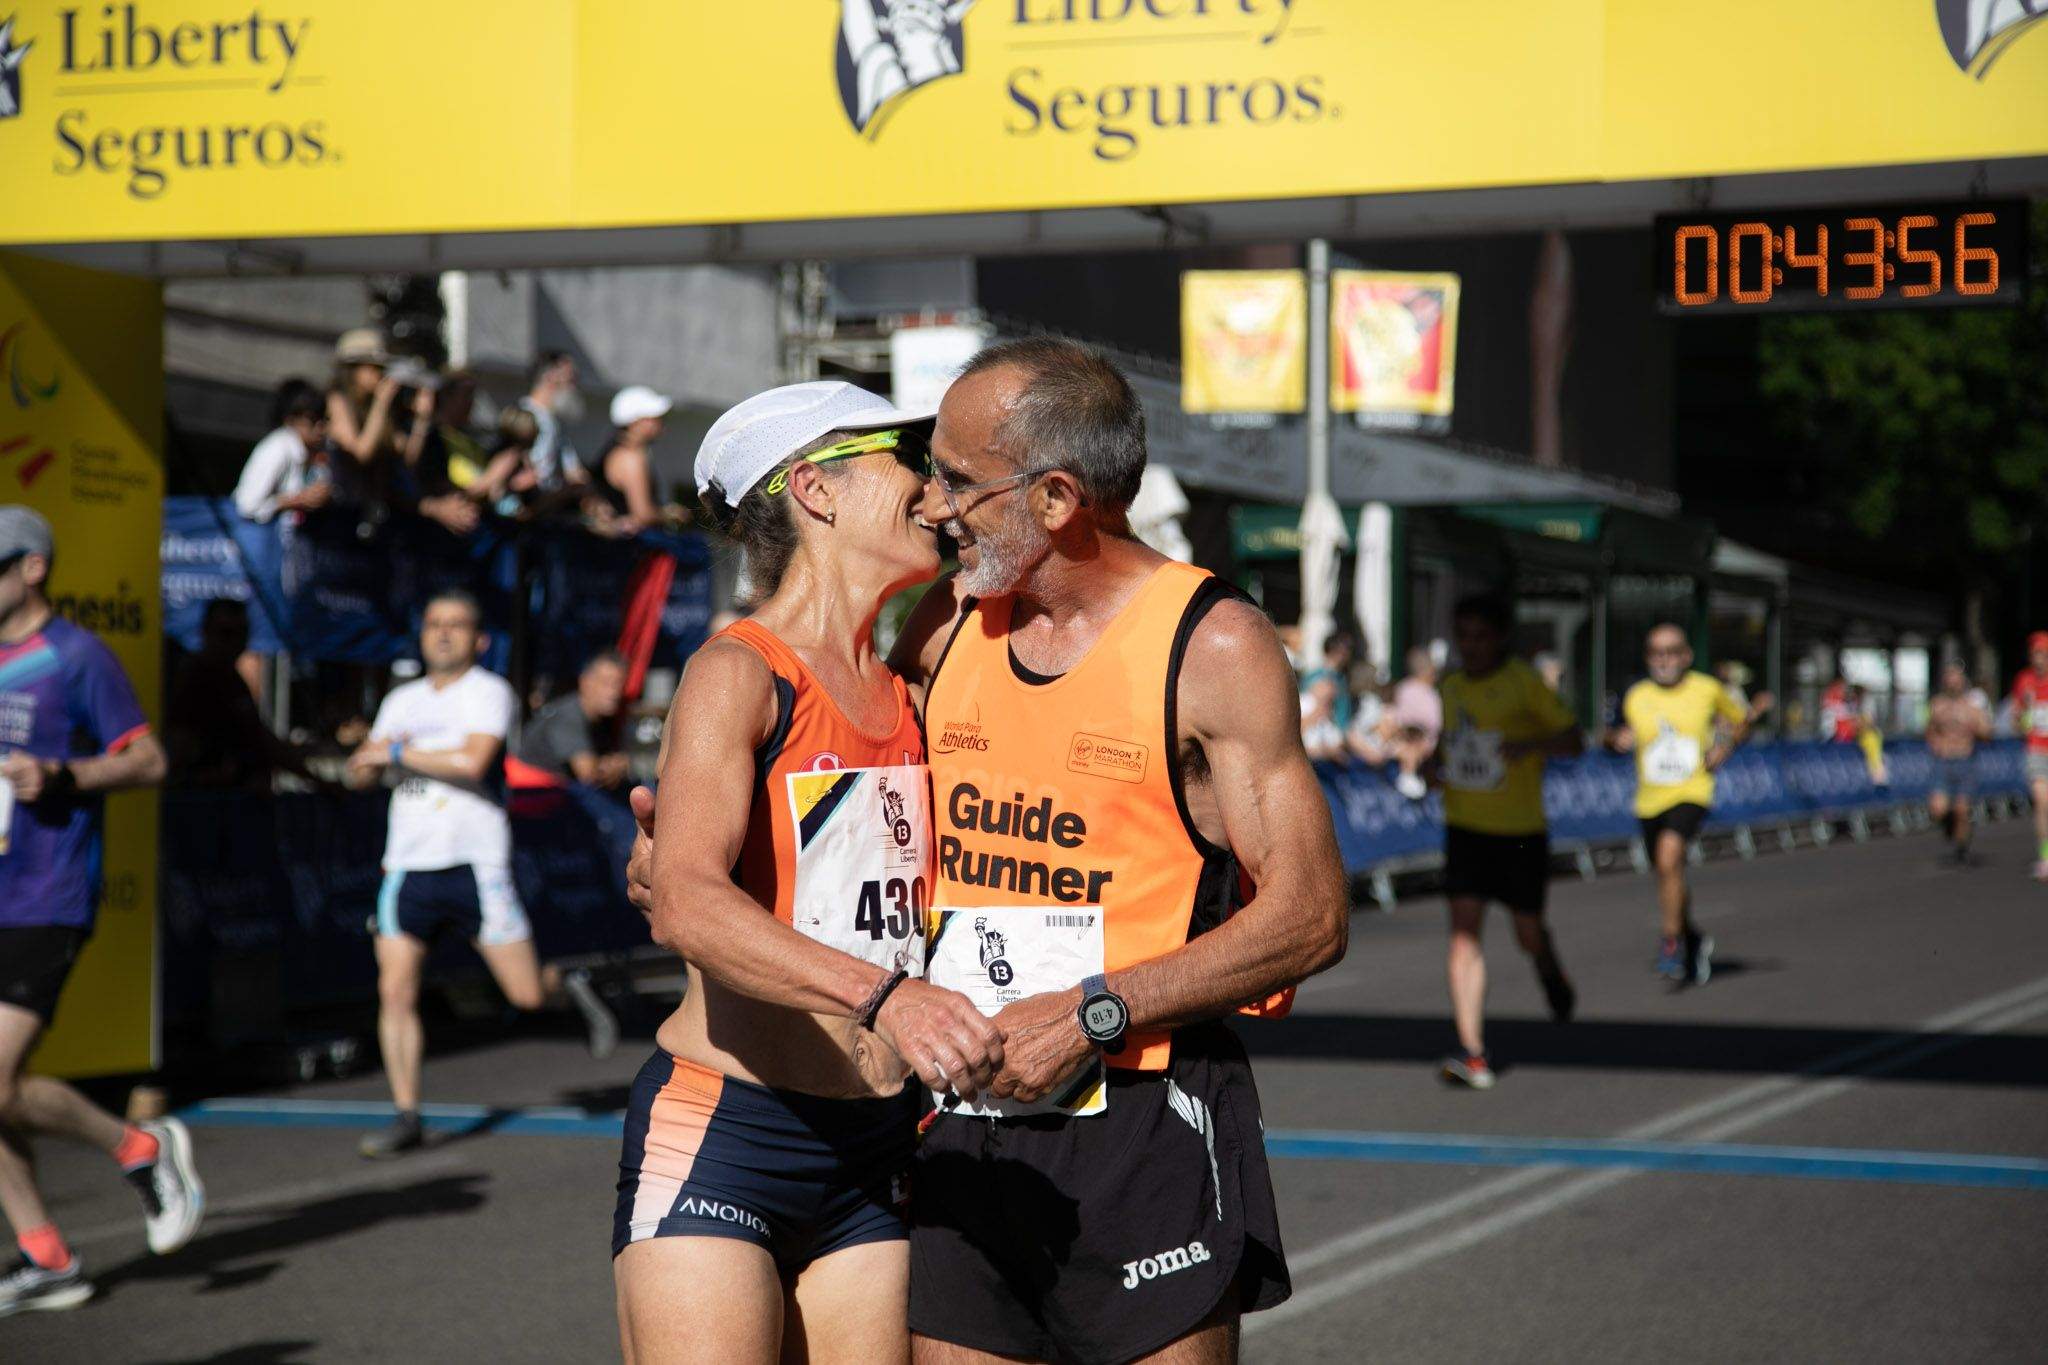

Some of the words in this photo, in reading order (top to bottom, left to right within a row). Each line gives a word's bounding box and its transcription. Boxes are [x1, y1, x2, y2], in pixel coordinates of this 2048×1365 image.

[58, 3, 312, 93] Liberty
[1675, 212, 1999, 305] 00:43:56
[55, 579, 146, 636] nesis
[939, 731, 990, 751] Athletics
[1095, 753, 1142, 769] MARATHON
[1096, 745, 1132, 759] LONDON
[896, 825, 909, 840] 13
[949, 782, 1087, 848] Guide
[900, 855, 917, 863] Liberty
[940, 834, 1113, 904] Runner
[855, 876, 926, 941] 430
[992, 965, 1009, 980] 13
[1123, 1241, 1211, 1290] Joma
